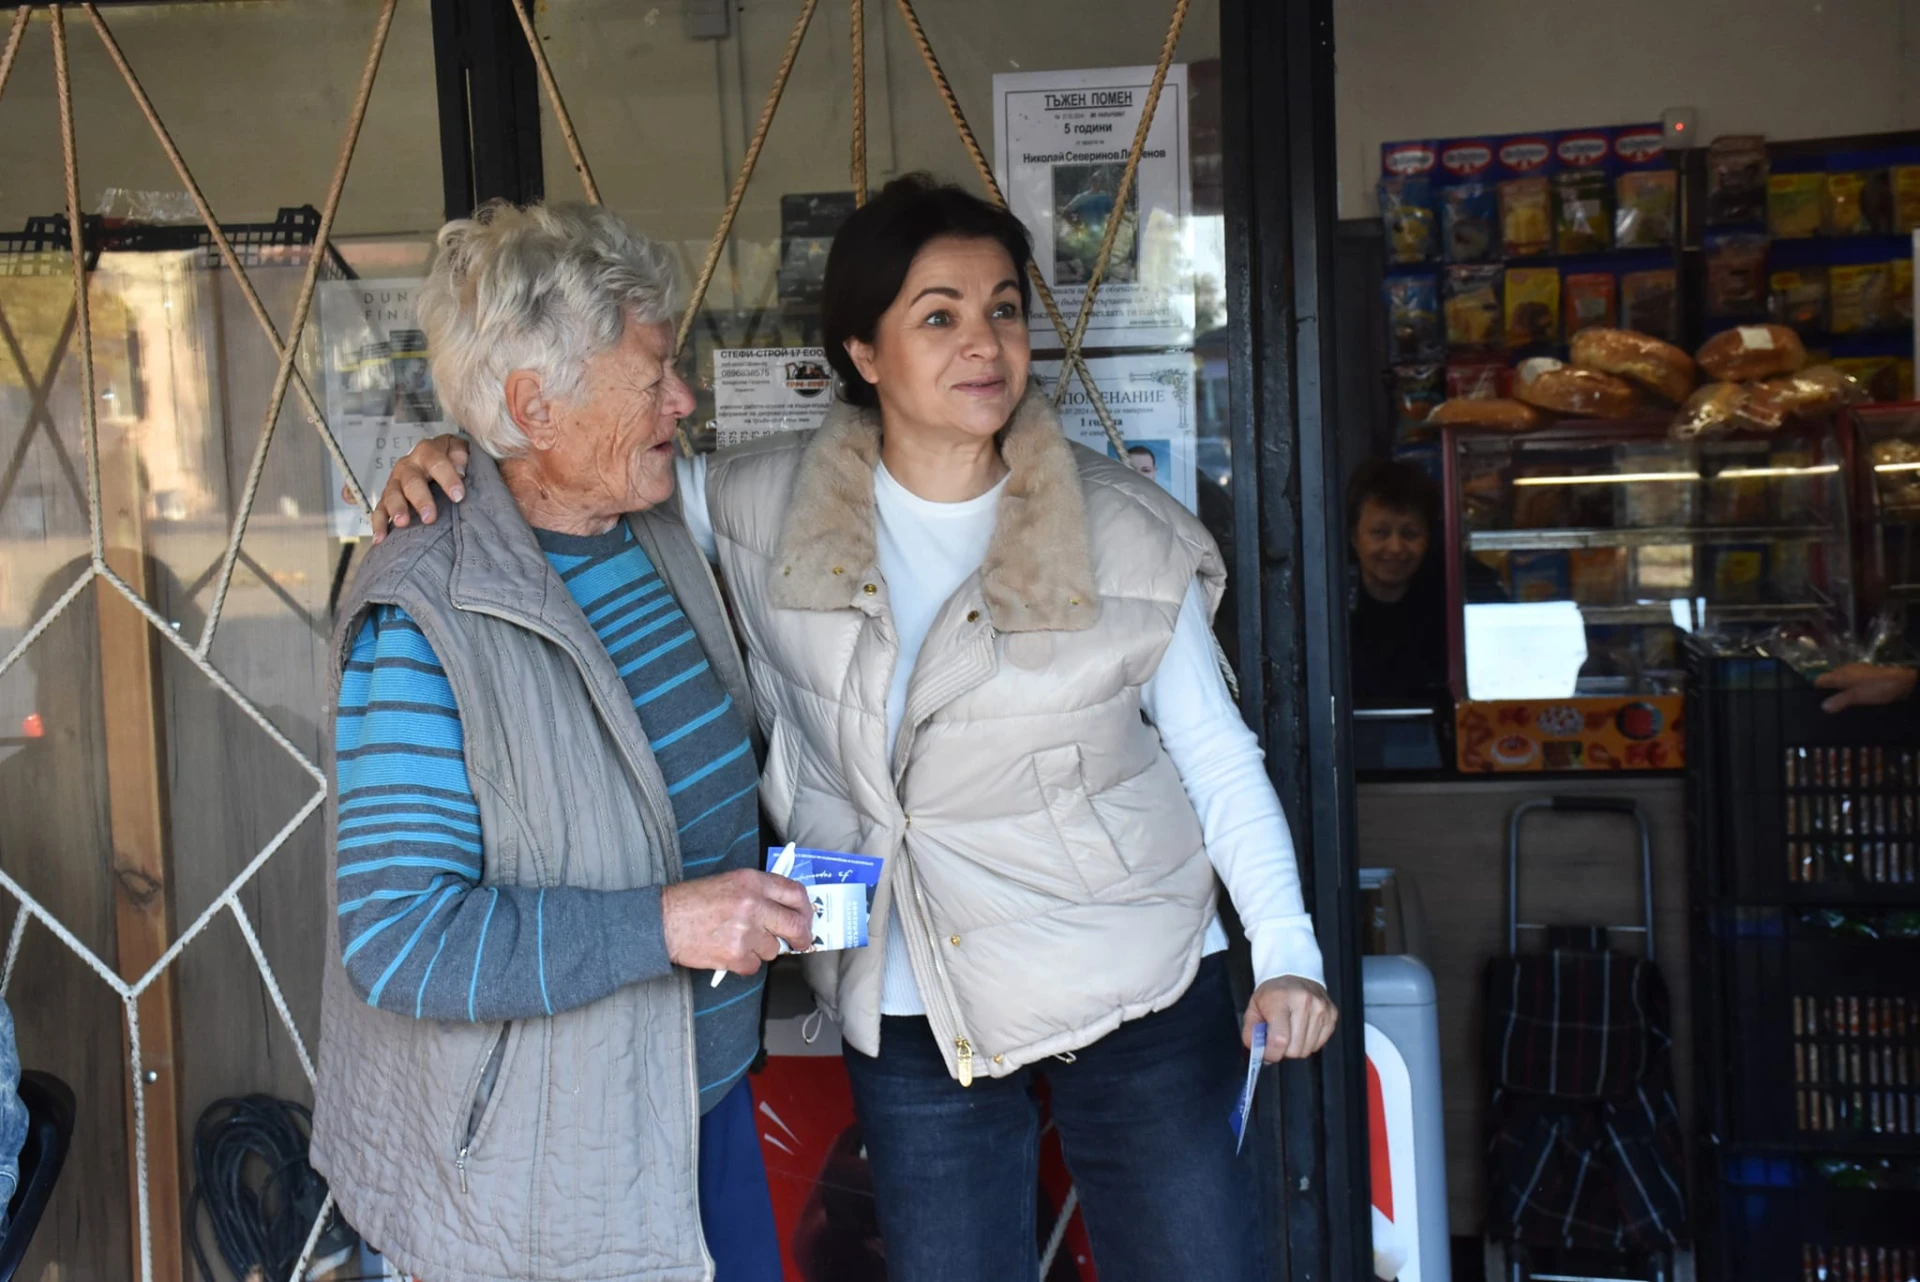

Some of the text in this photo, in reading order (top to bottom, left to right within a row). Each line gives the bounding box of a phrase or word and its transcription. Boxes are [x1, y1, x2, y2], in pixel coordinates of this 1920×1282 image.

[1044, 91, 1132, 107] ТЪЖЕН ПОМЕН
[1064, 122, 1112, 135] 5 години
[1023, 152, 1064, 164] Николай
[1065, 150, 1119, 162] Северинов
[363, 291, 420, 304] DUN
[1080, 417, 1085, 427] 1
[375, 436, 415, 450] DET
